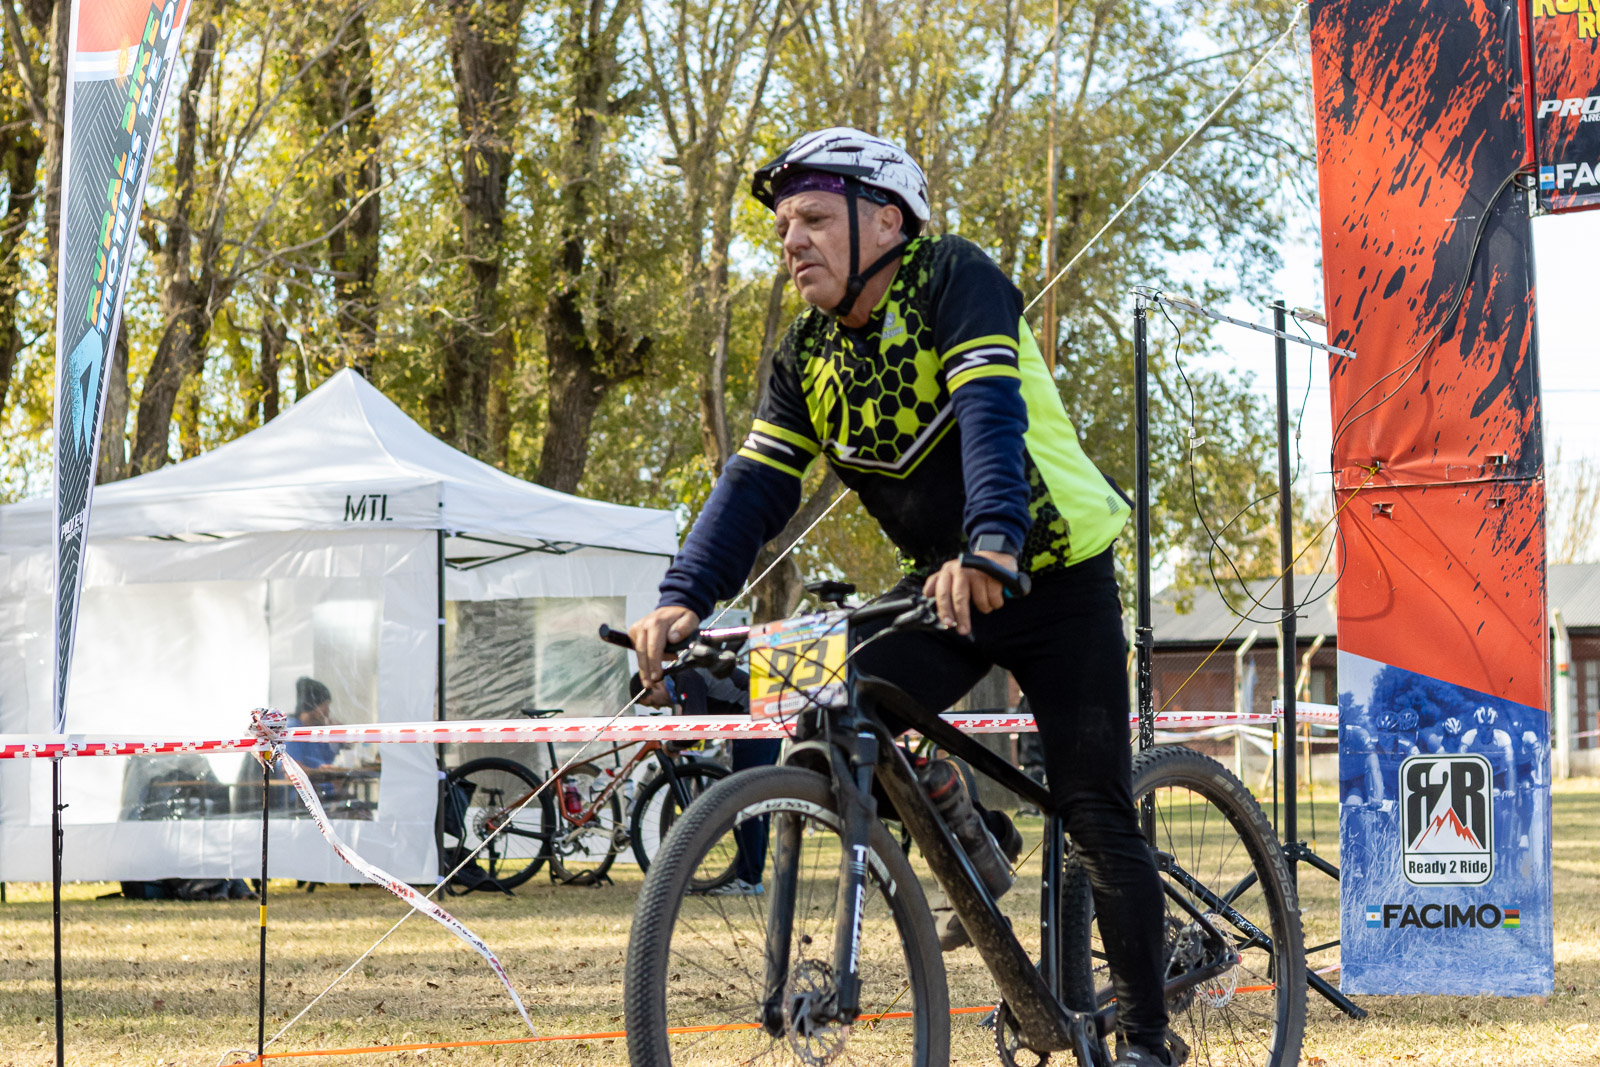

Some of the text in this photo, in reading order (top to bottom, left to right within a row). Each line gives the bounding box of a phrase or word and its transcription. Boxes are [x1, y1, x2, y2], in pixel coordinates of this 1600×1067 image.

[1537, 95, 1600, 119] PRO
[86, 10, 160, 330] RURAL BIKE
[96, 129, 142, 336] MONTES
[138, 48, 163, 119] DE
[343, 494, 393, 521] MTL
[1234, 792, 1296, 912] ROCKET RON
[1408, 860, 1488, 875] Ready 2 Ride
[1383, 903, 1502, 929] FACIMO
